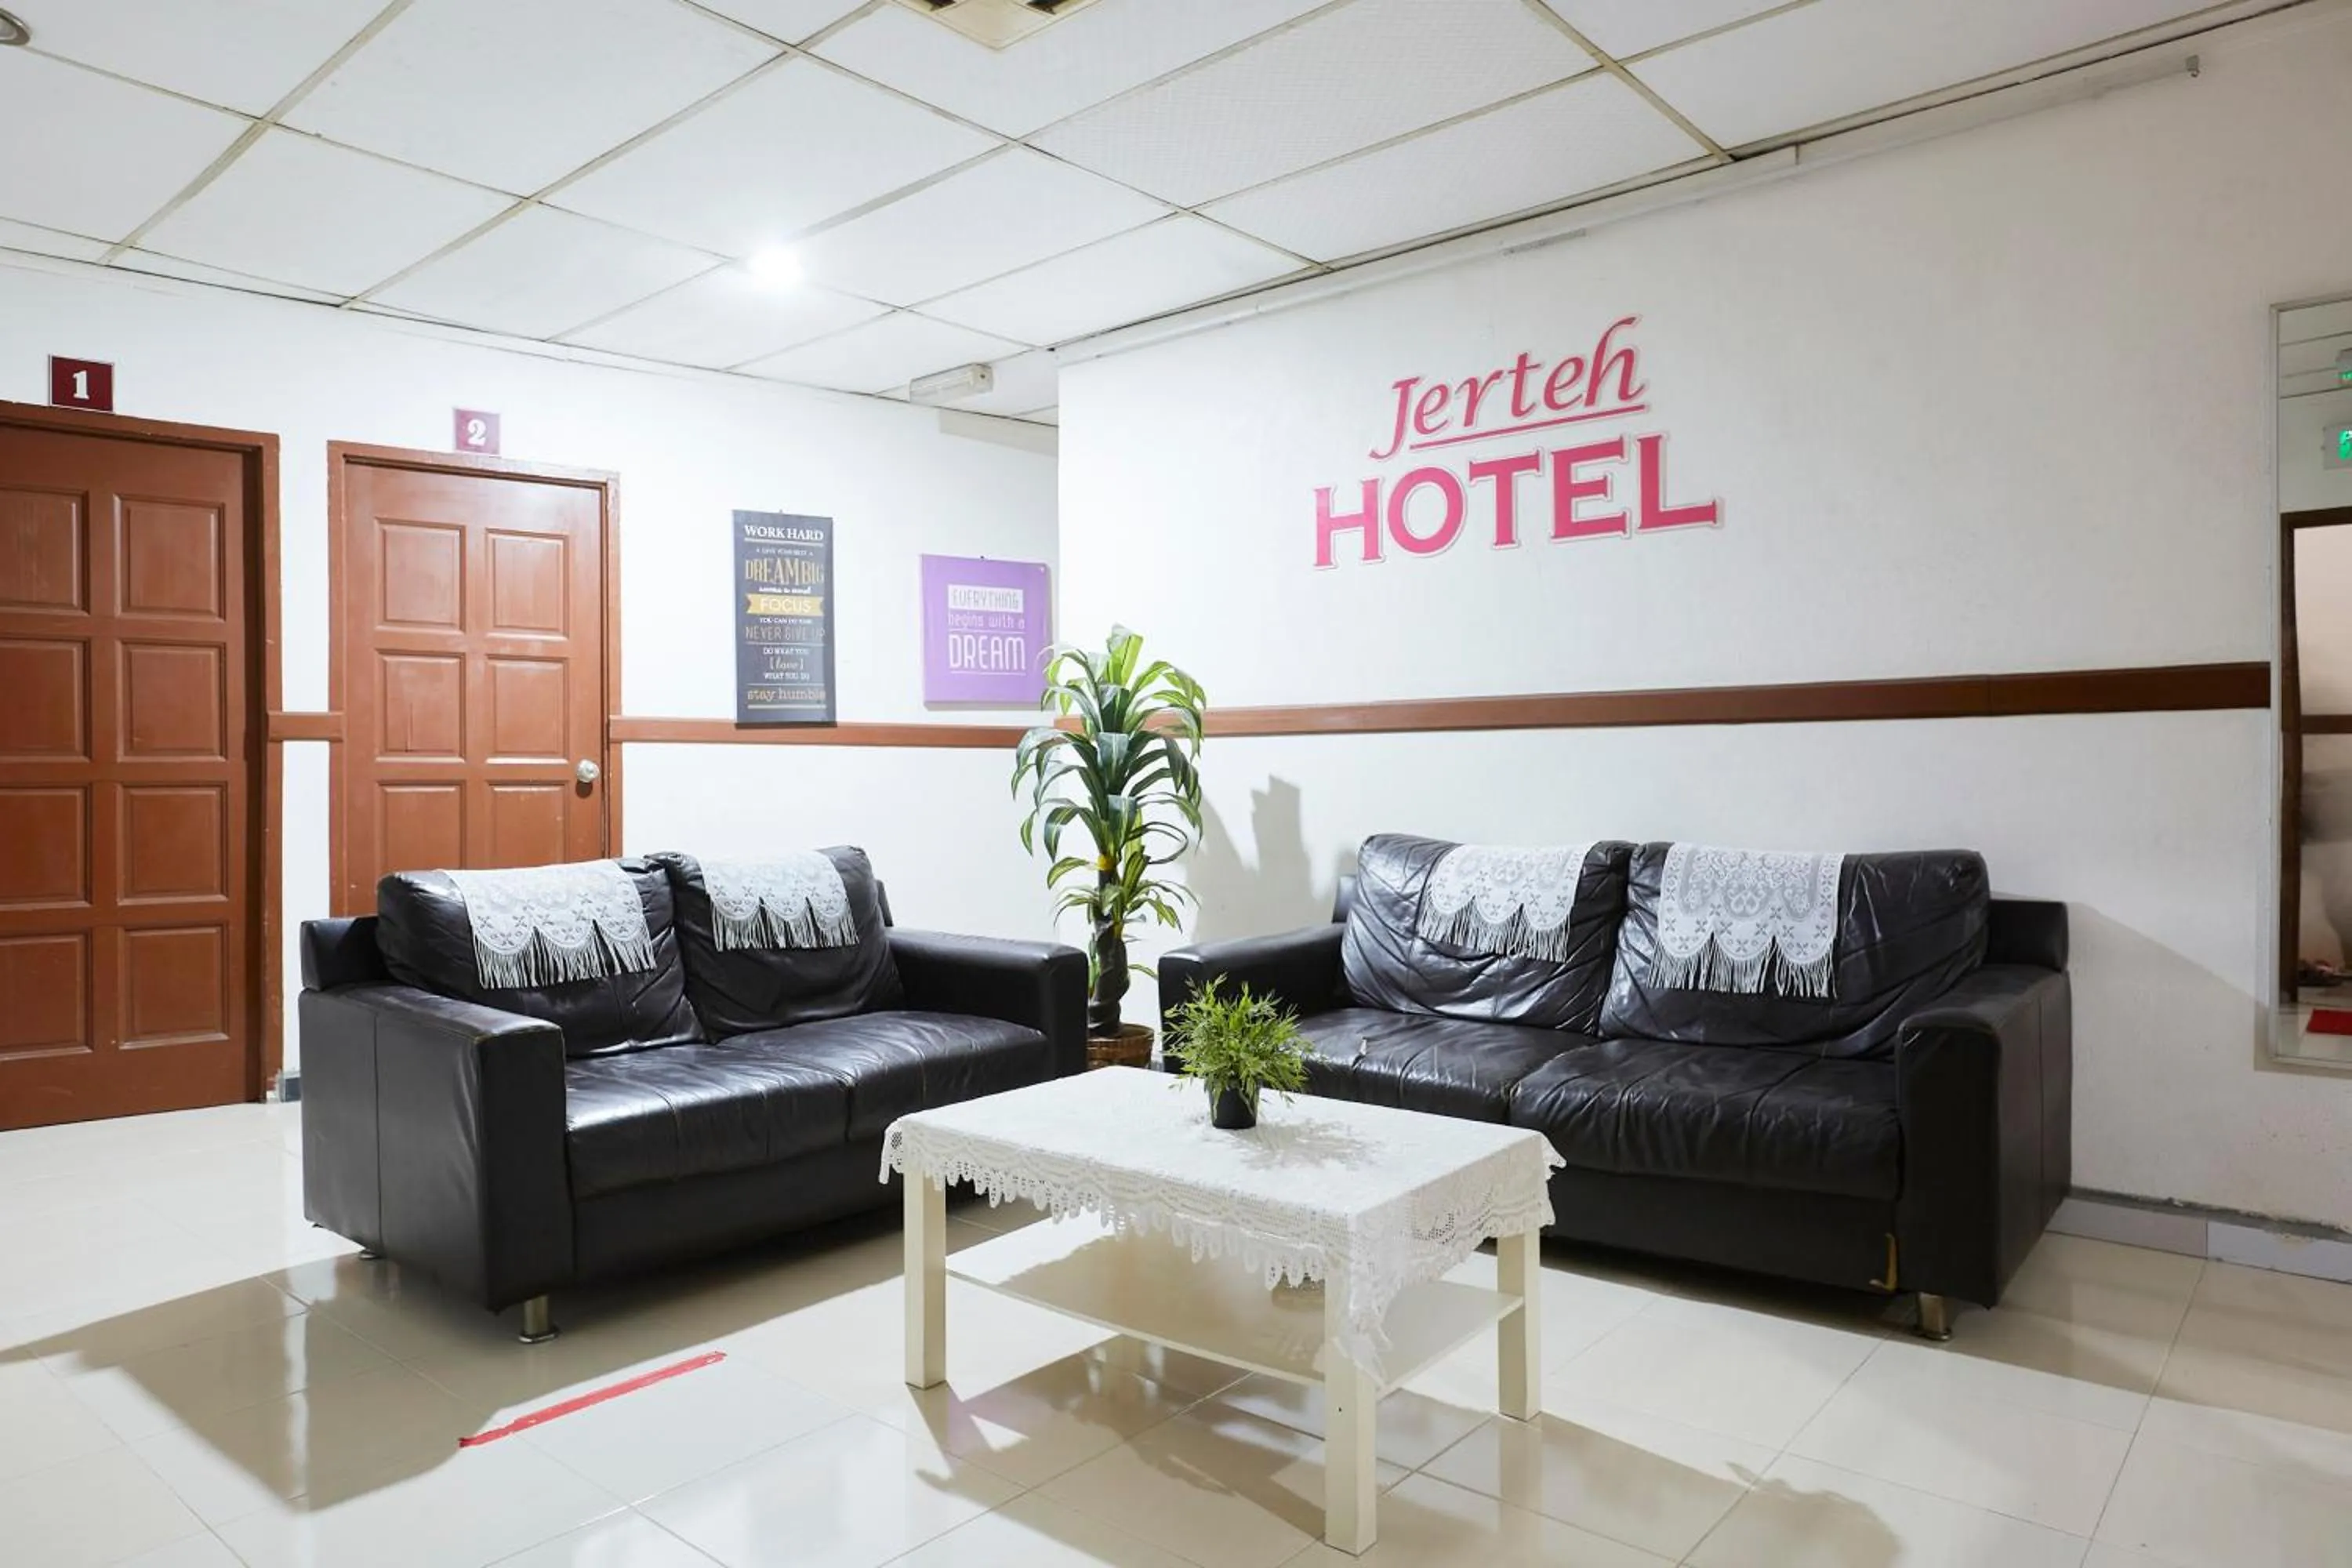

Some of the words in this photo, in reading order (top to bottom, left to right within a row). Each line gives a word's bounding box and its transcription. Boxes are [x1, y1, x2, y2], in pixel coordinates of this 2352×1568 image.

[71, 370, 90, 400] 1
[1367, 314, 1646, 460] Jerteh
[466, 419, 486, 447] 2
[1312, 434, 1719, 568] HOTEL
[744, 524, 785, 539] WORK
[787, 528, 824, 540] HARD
[745, 557, 799, 586] DREAM
[760, 598, 811, 612] FOCUS
[952, 588, 1019, 609] EVERYTHING
[746, 626, 781, 641] NEVER
[948, 609, 984, 630] begins
[988, 613, 1014, 628] with
[1018, 619, 1025, 630] a
[948, 633, 1026, 671] DREAM
